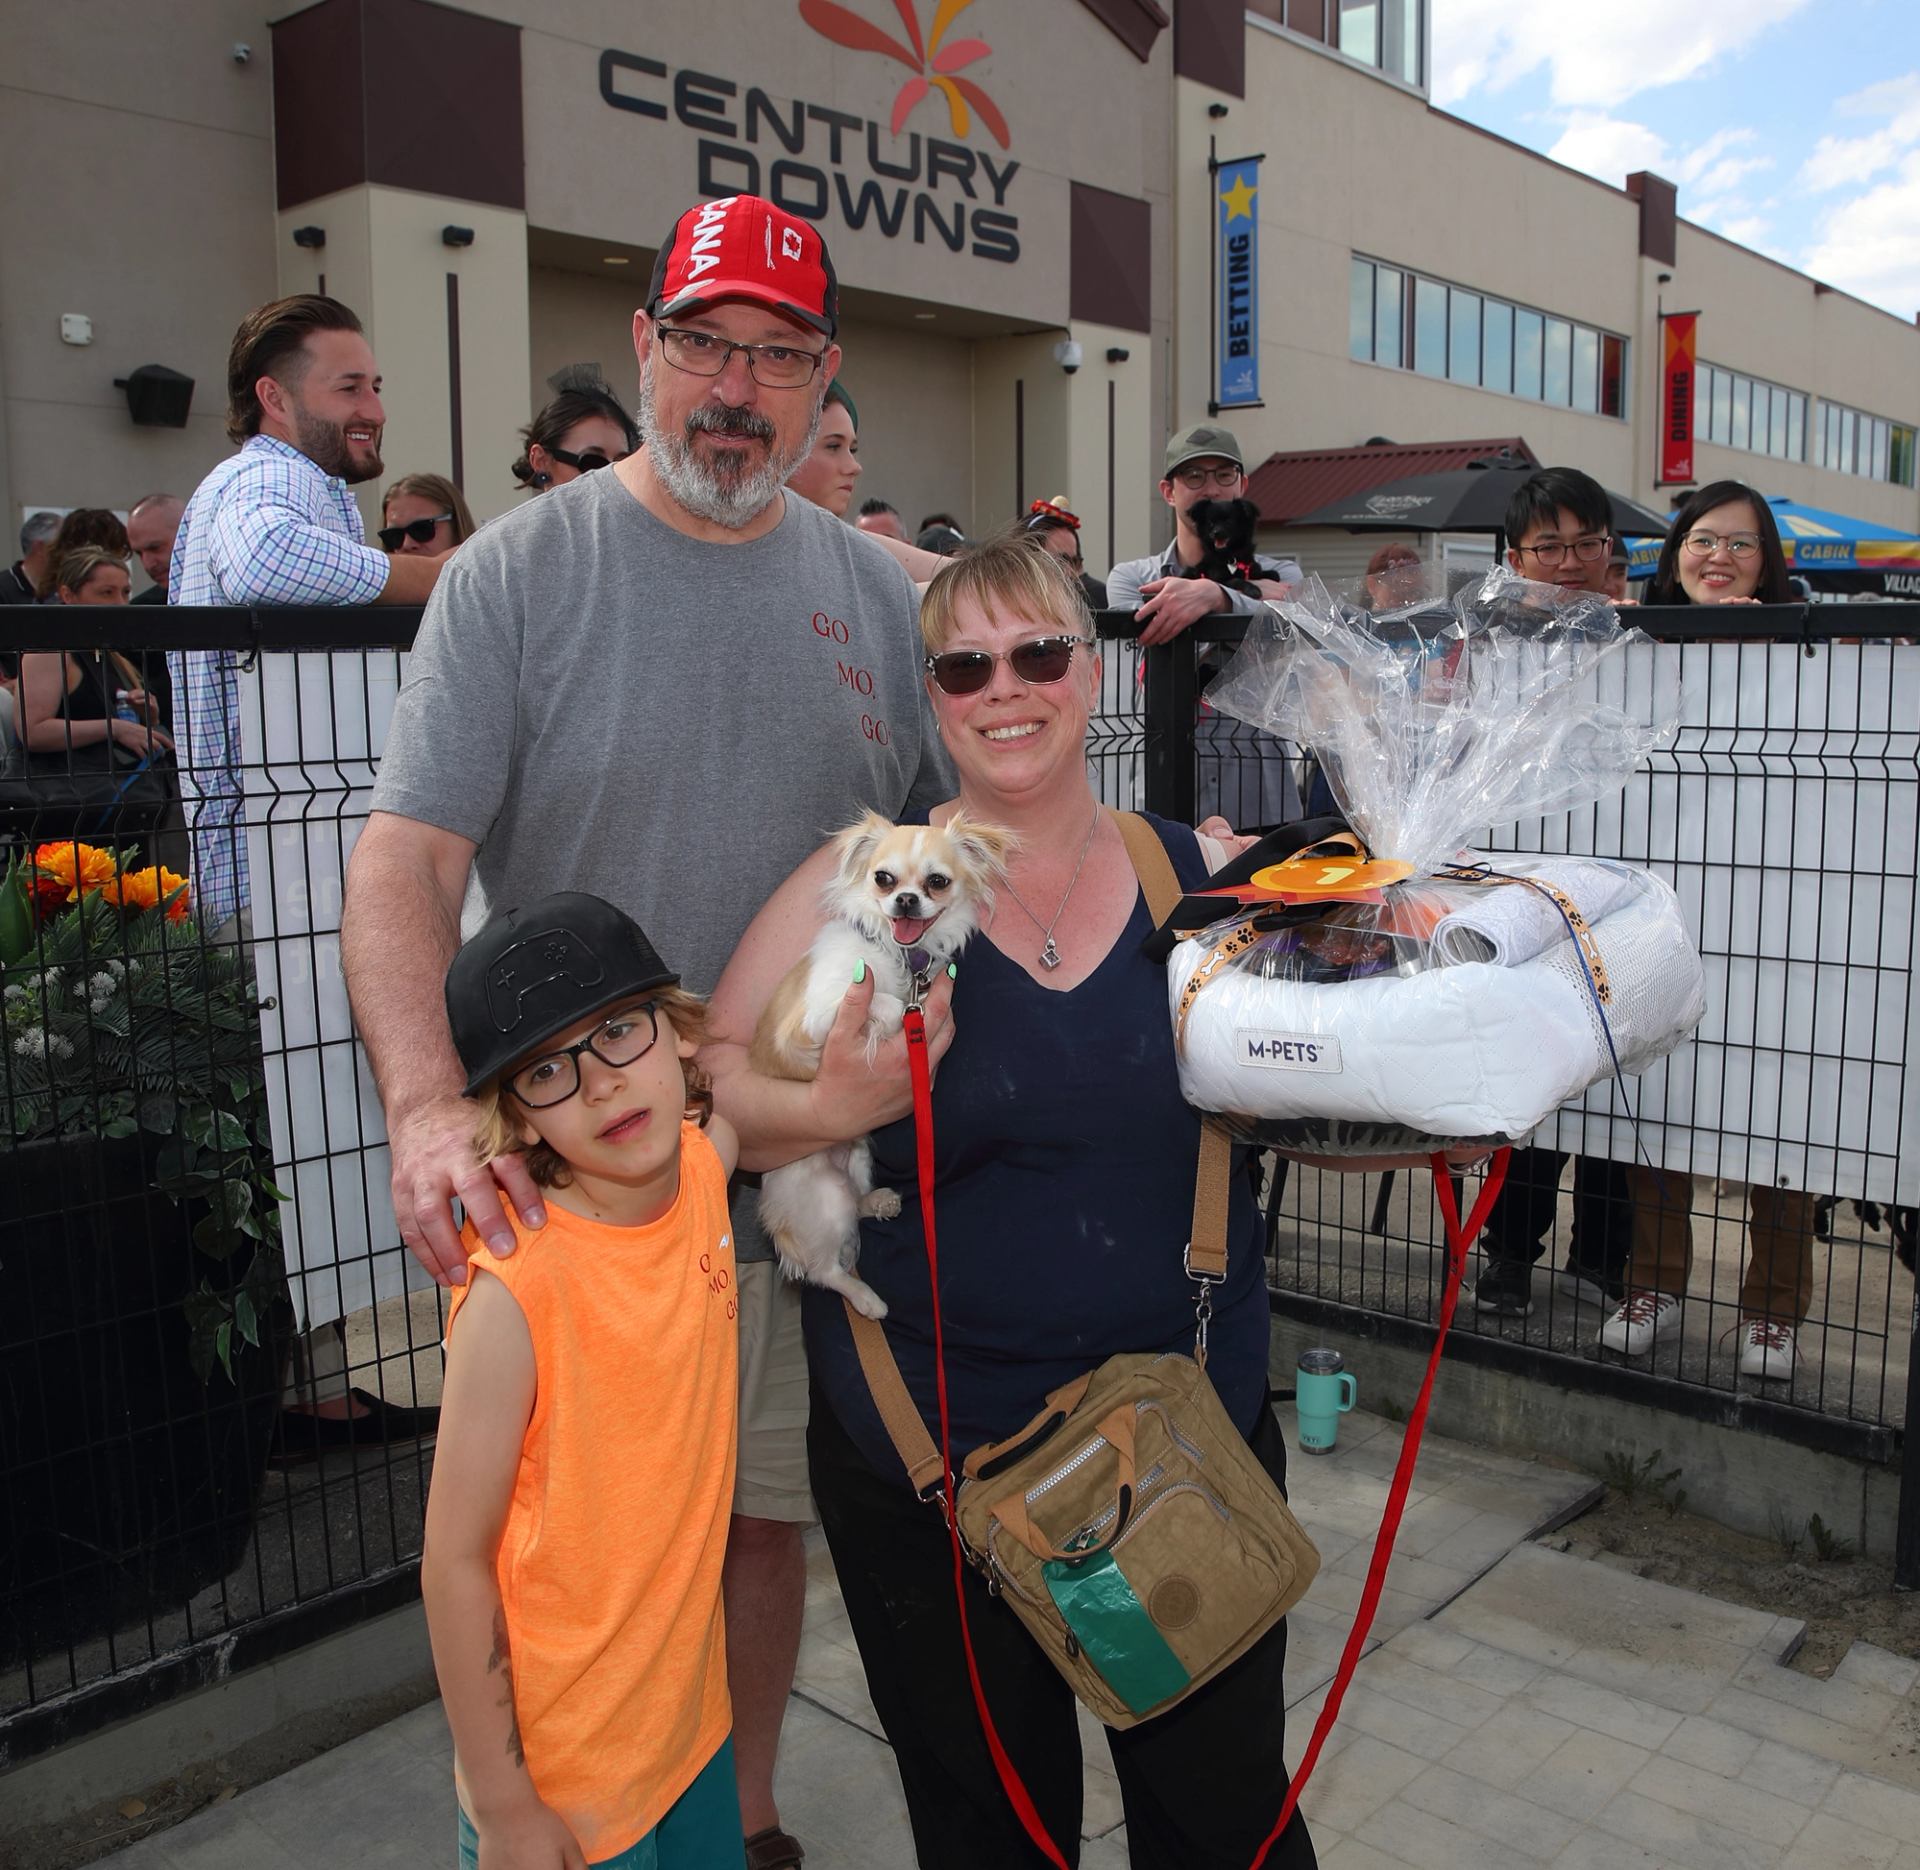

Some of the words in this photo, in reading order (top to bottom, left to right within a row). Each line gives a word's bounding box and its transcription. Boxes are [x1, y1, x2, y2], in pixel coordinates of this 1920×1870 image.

[600, 48, 1020, 206] CENTURY
[699, 138, 1020, 264] DOWNS
[1229, 233, 1250, 359] BETTING
[1672, 370, 1690, 441] DINING
[1801, 544, 1850, 559] CABIN
[812, 612, 849, 644] GO
[1316, 867, 1356, 885] 1
